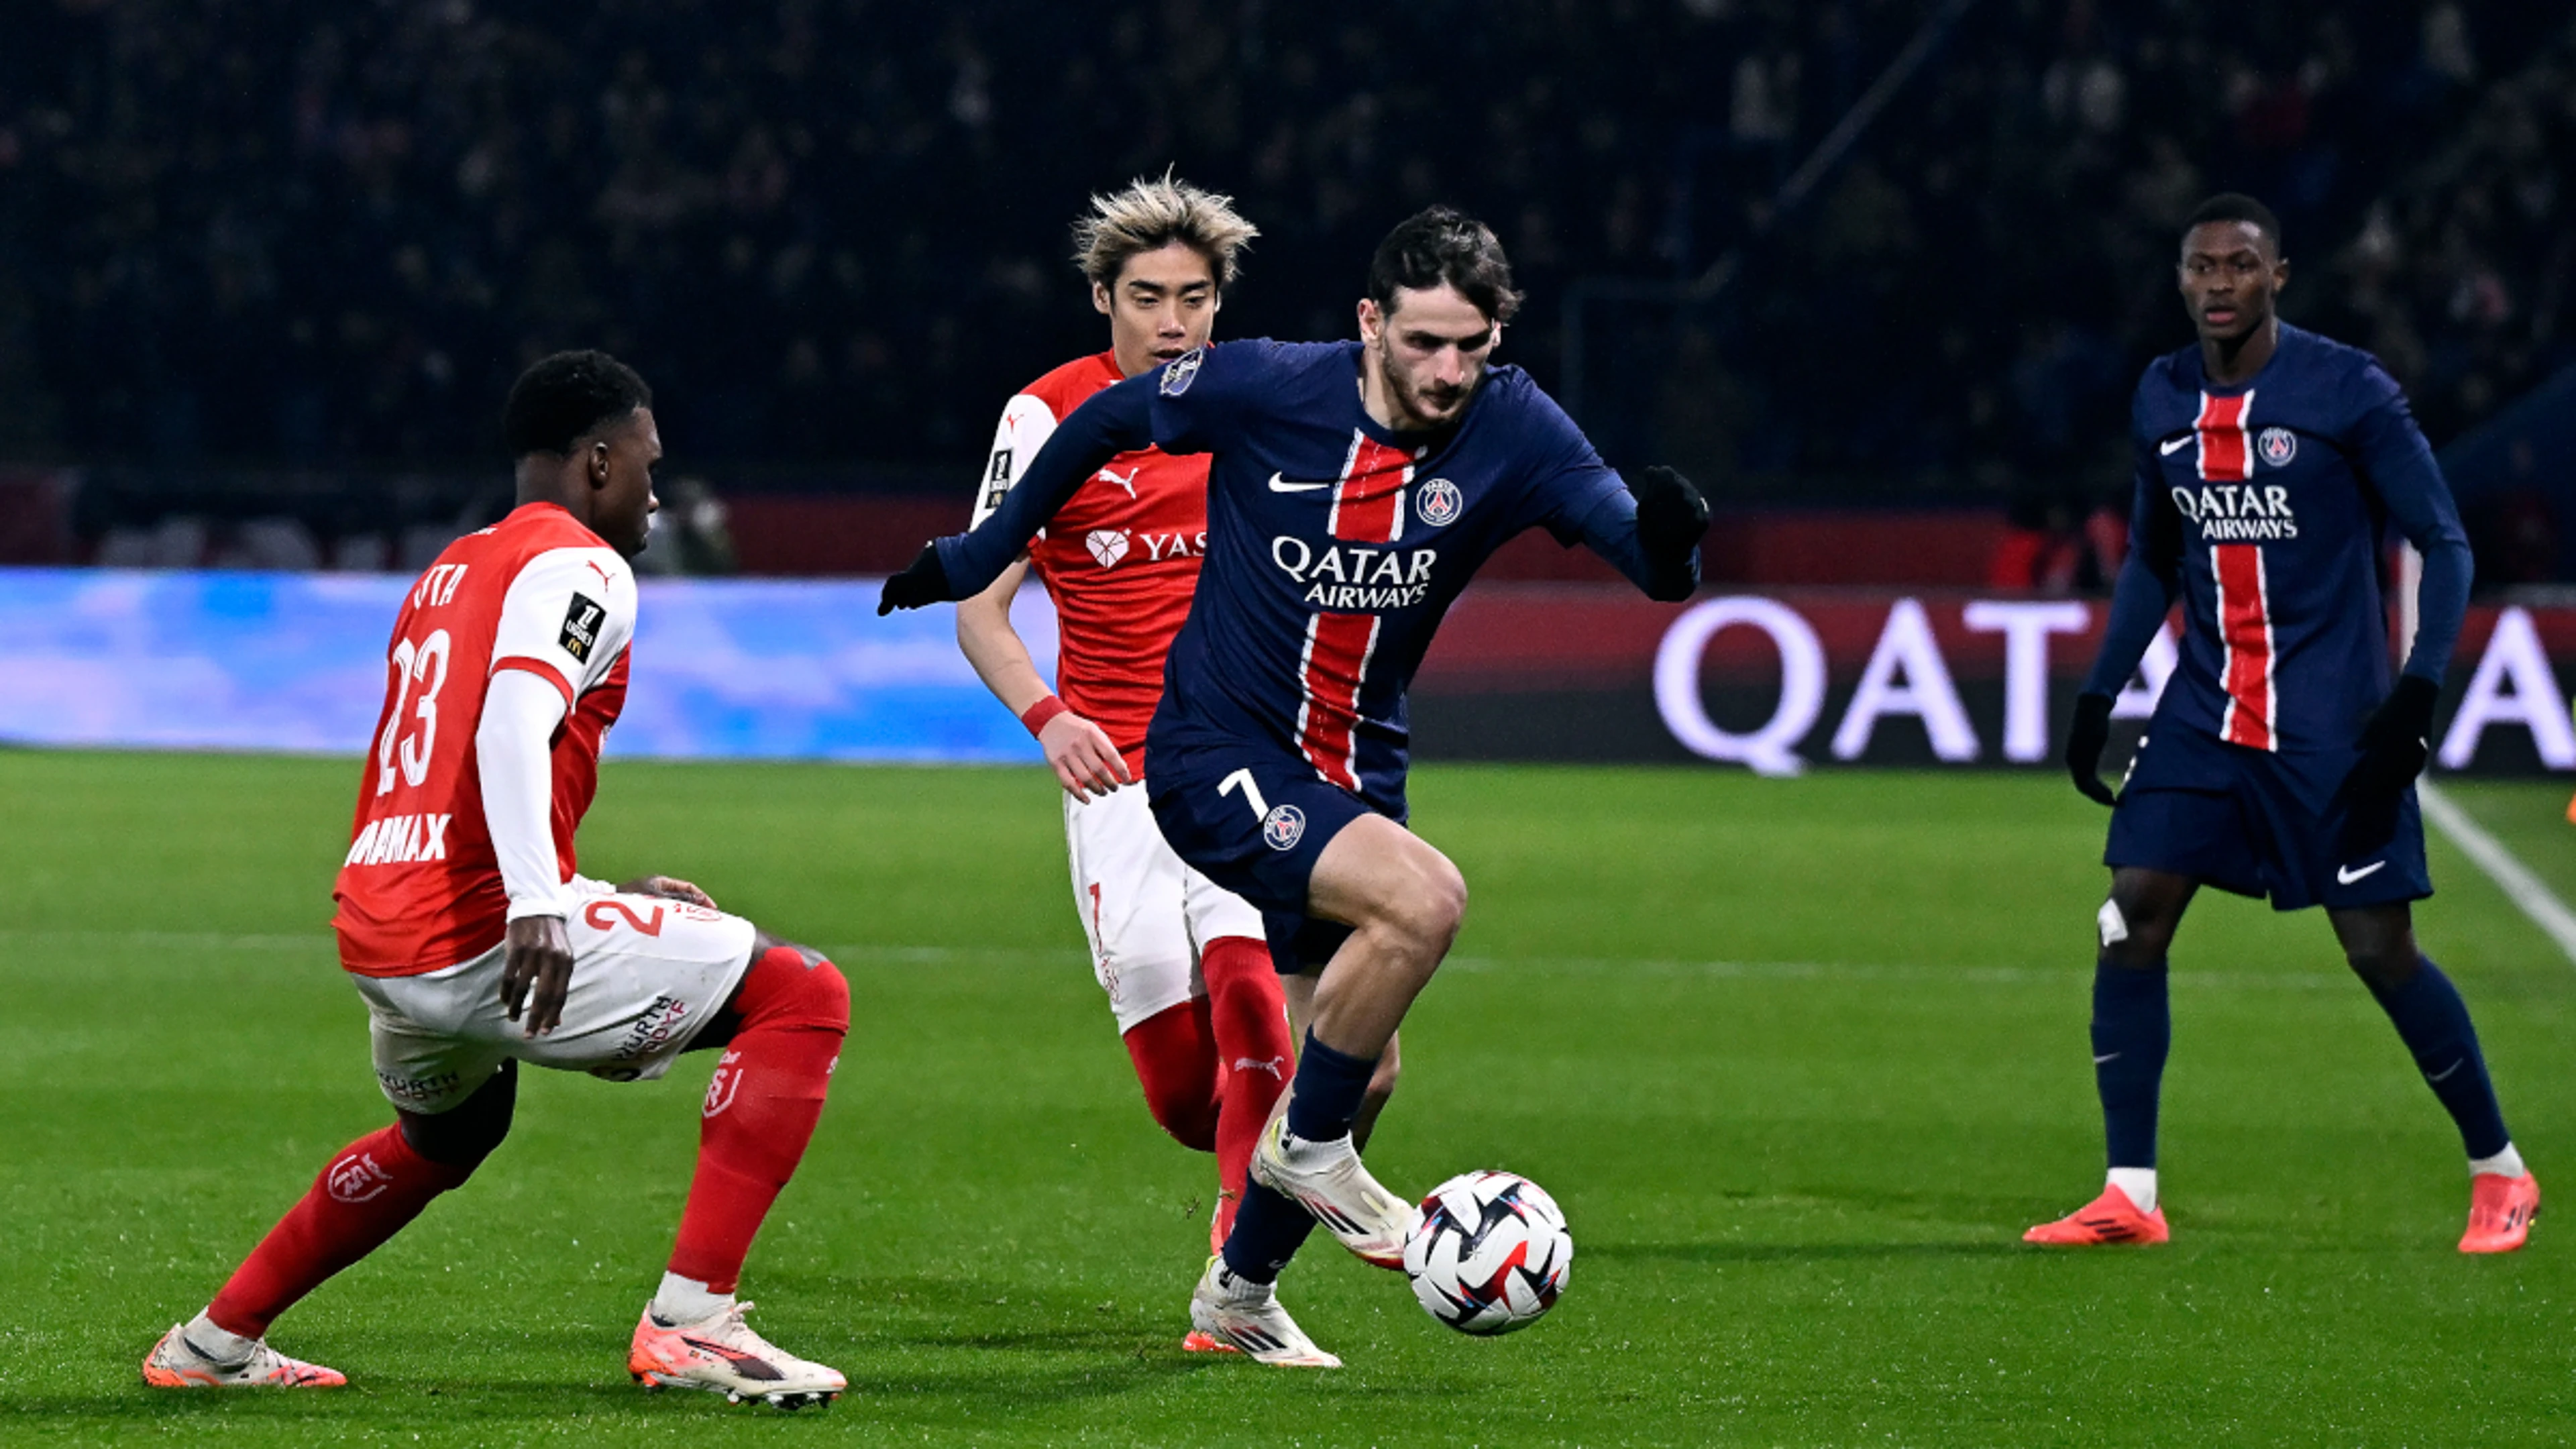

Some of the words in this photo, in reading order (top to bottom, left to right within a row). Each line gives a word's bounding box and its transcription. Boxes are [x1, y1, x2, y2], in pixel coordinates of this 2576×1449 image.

[2172, 486, 2294, 523] QATAR
[2202, 519, 2298, 539] AIRWAYS
[1273, 536, 1436, 585] QATAR
[1305, 582, 1428, 608] AIRWAYS
[1653, 596, 2179, 777] QAT
[376, 629, 451, 797] 23
[1218, 768, 1269, 822] 7
[584, 893, 663, 938] 2
